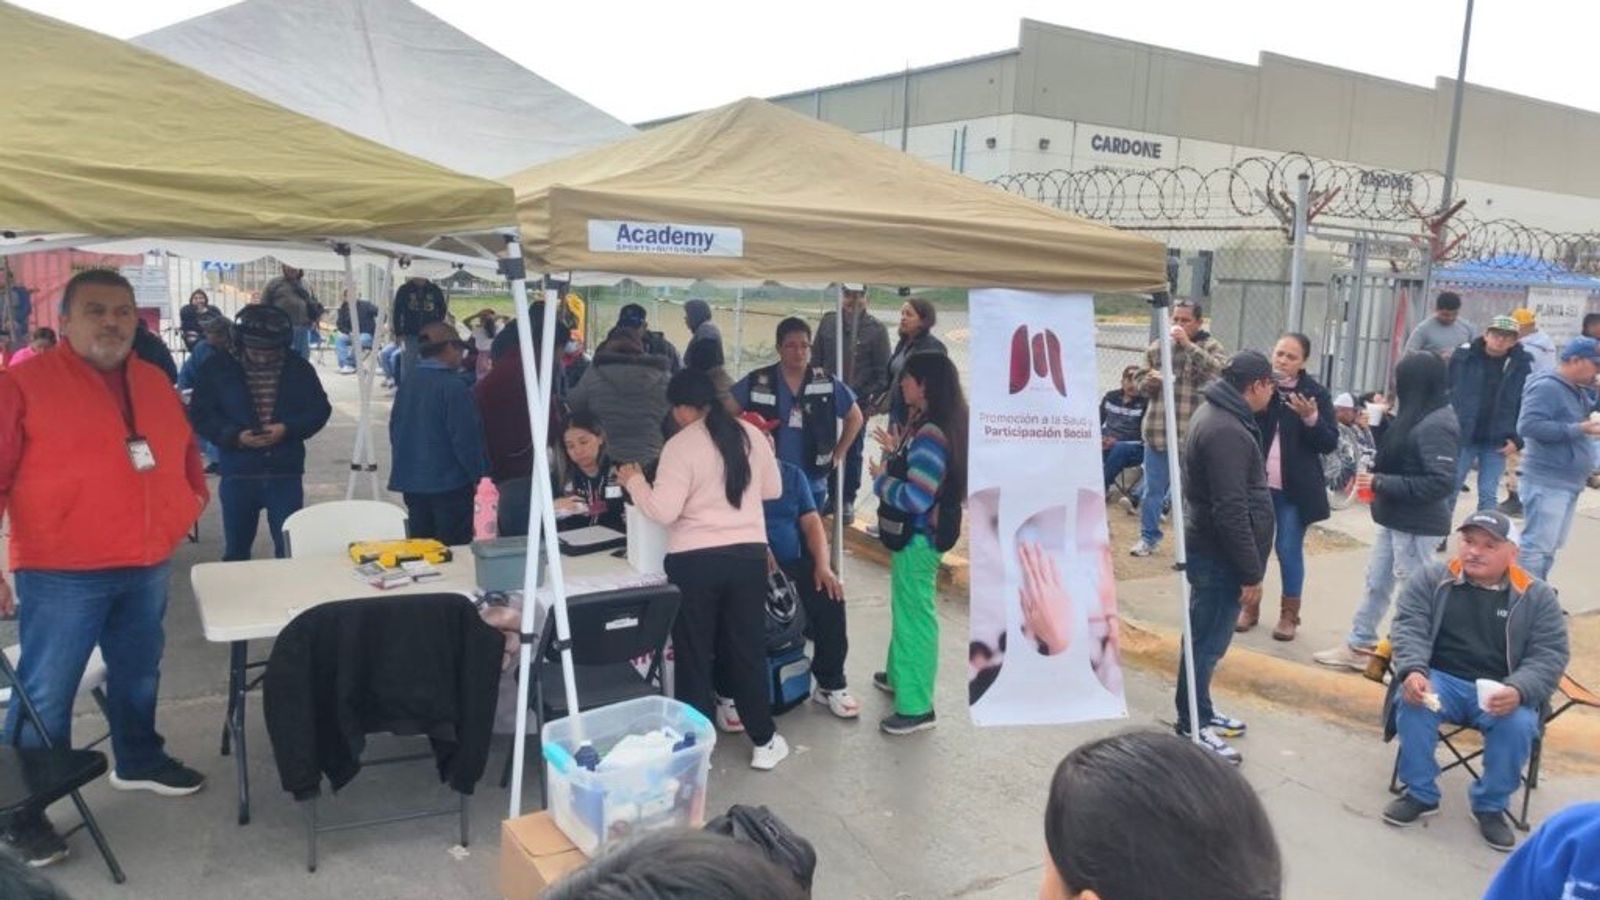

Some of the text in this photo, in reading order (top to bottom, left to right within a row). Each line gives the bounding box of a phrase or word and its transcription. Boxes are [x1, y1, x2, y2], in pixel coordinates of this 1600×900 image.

[1091, 134, 1162, 159] CARDONE
[617, 223, 714, 252] Academy
[979, 411, 1039, 425] Promoción
[1042, 415, 1048, 425] a
[1051, 415, 1061, 425] la
[984, 425, 1092, 439] Participación Social
